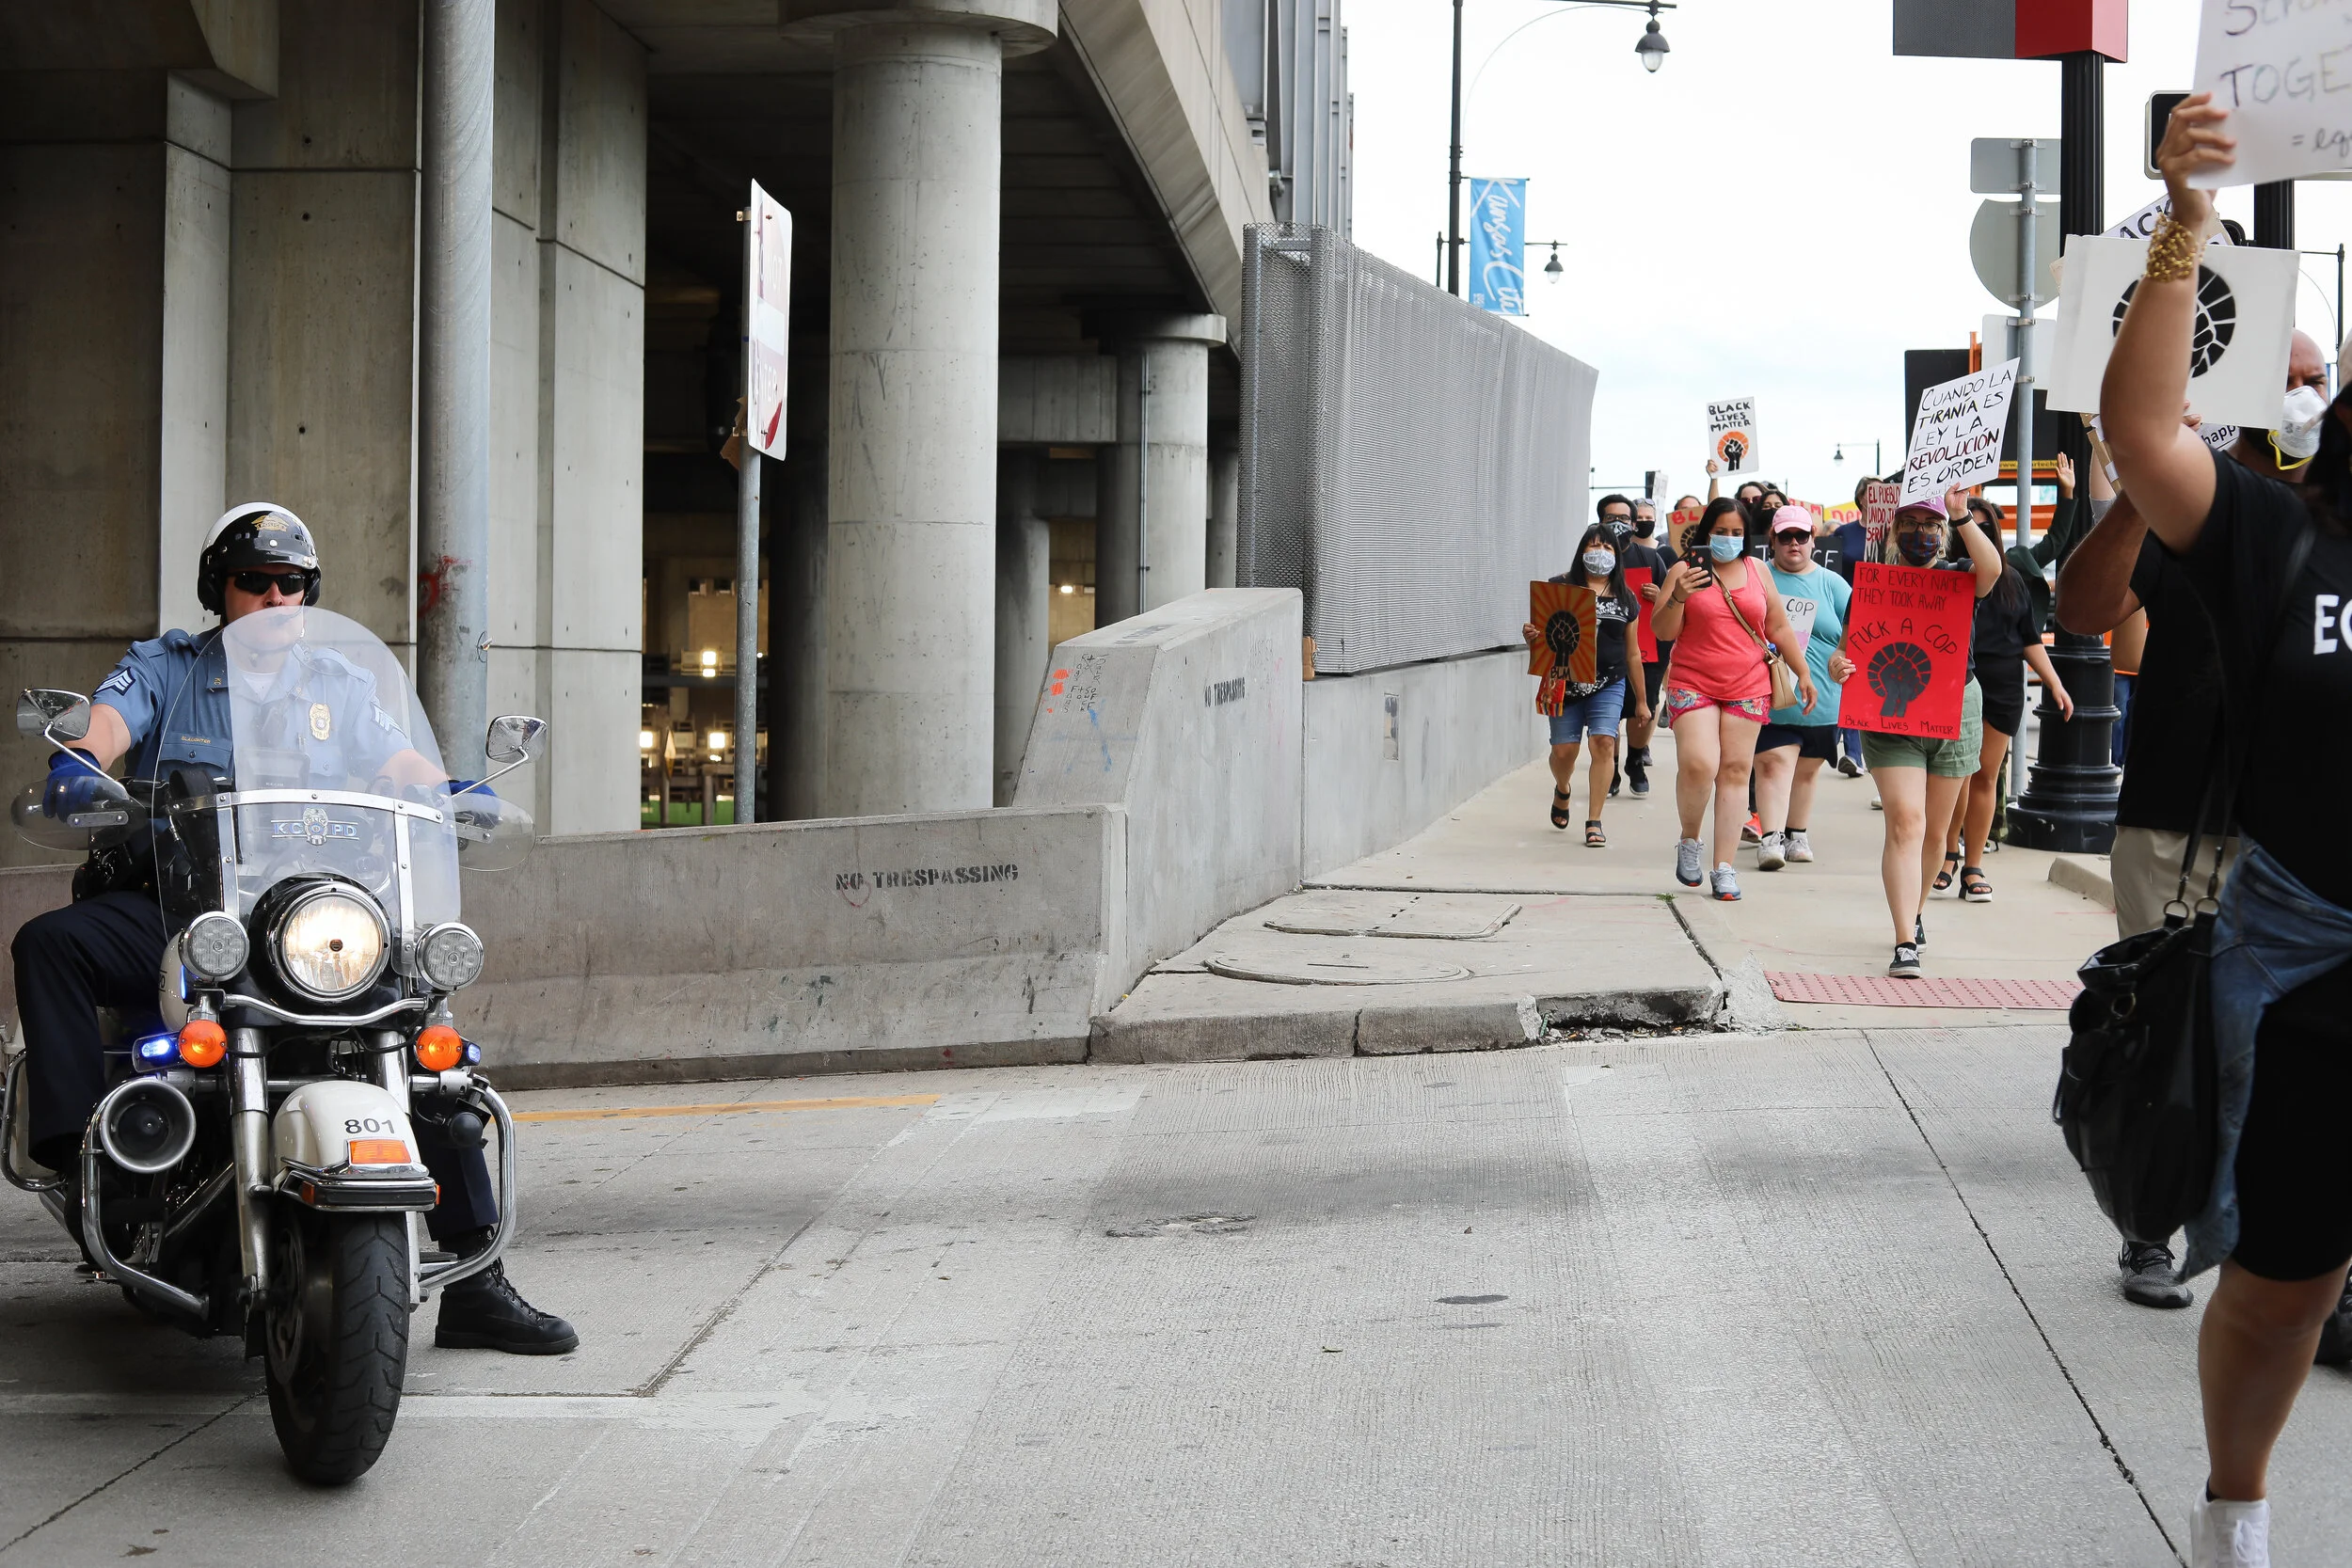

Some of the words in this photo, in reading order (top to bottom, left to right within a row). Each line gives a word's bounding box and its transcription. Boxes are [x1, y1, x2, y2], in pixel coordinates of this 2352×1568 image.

[1921, 378, 1985, 411] CUANDO
[1989, 369, 2011, 388] LA
[1983, 391, 2004, 408] ES
[1708, 402, 1751, 415] BLACK
[1715, 412, 1746, 422] LIVES
[1710, 420, 1751, 432] MATTER
[1914, 426, 1948, 452] LEY
[1956, 416, 1982, 438] LA
[1909, 427, 2000, 472] REVOLUCIÓN
[1908, 472, 1930, 494] ES
[1936, 448, 1996, 484] ORDEN
[1868, 486, 1878, 504] EL
[1859, 566, 1880, 584] FOR
[1888, 570, 1927, 588] EVERY
[1931, 575, 1963, 594] NAME
[1786, 598, 1815, 616] COP
[1857, 587, 1885, 605] THEY
[1889, 590, 1915, 609] TOOK
[1917, 594, 1947, 610] AWAY
[1849, 620, 1891, 655] FUCK
[1900, 617, 1913, 636] A
[1924, 624, 1958, 655] COP
[1214, 676, 1246, 706] TRESPASSING
[1881, 717, 1909, 731] LIVES
[1920, 721, 1954, 735] MATTER
[331, 824, 358, 837] PD
[836, 872, 865, 890] NO
[872, 863, 1019, 889] TRESPASSING
[344, 1117, 395, 1134] 801
